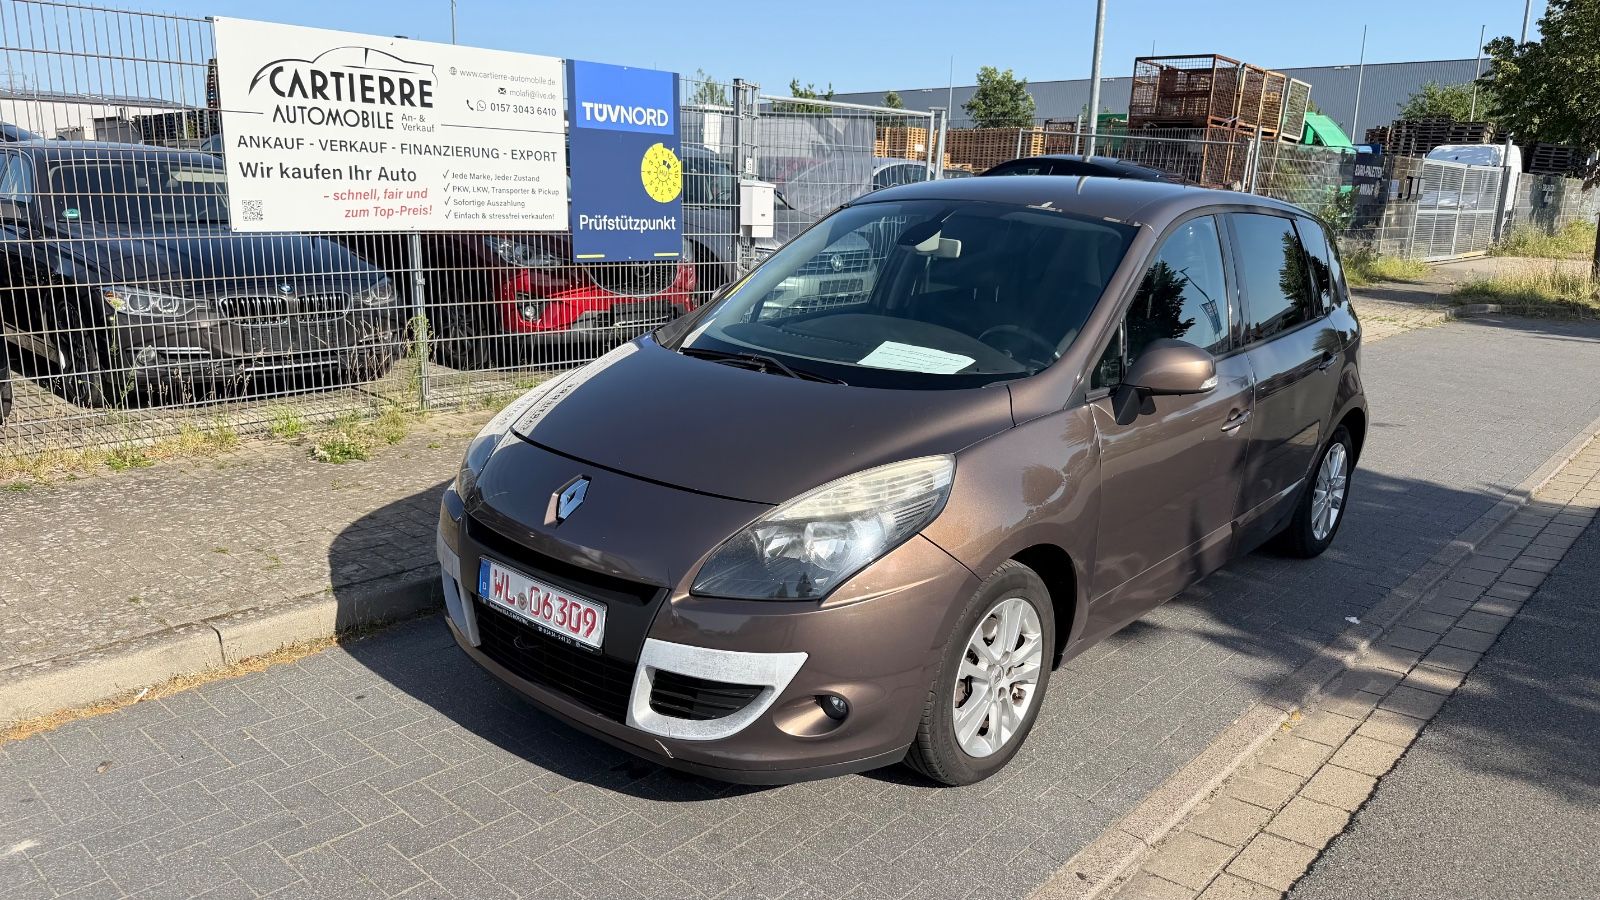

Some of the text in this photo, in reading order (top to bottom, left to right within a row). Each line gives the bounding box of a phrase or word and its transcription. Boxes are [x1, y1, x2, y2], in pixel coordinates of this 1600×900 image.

[460, 69, 556, 86] www.cartierre-automobile.de
[269, 65, 434, 109] CARTIERRE
[272, 104, 394, 130] AUTOMOBILE
[490, 102, 557, 117] 0157 3043 6410
[418, 114, 426, 123] &
[401, 122, 435, 133] Verkauf
[237, 135, 305, 151] ANKAUF
[318, 138, 388, 154] VERKAUF
[400, 143, 500, 159] FINANZIERUNG
[511, 149, 558, 162] EXPORT
[239, 161, 417, 182] Wir kaufen Ihr Auto
[513, 174, 540, 182] Zustand
[333, 188, 380, 202] schnell,
[383, 188, 403, 200] fair
[406, 188, 428, 199] und
[452, 185, 471, 194] PKW,
[472, 186, 490, 194] LKW,
[491, 186, 530, 196] Transporter
[538, 188, 560, 197] Pickup
[453, 198, 526, 208] Sofortige Auszahlung
[344, 204, 433, 219] zum Top-Preis!
[453, 211, 480, 220] Einfach
[488, 212, 520, 220] stressfrei
[579, 214, 676, 233] Prüfstützpunkt
[494, 568, 517, 606] WL
[529, 585, 598, 639] 06309
